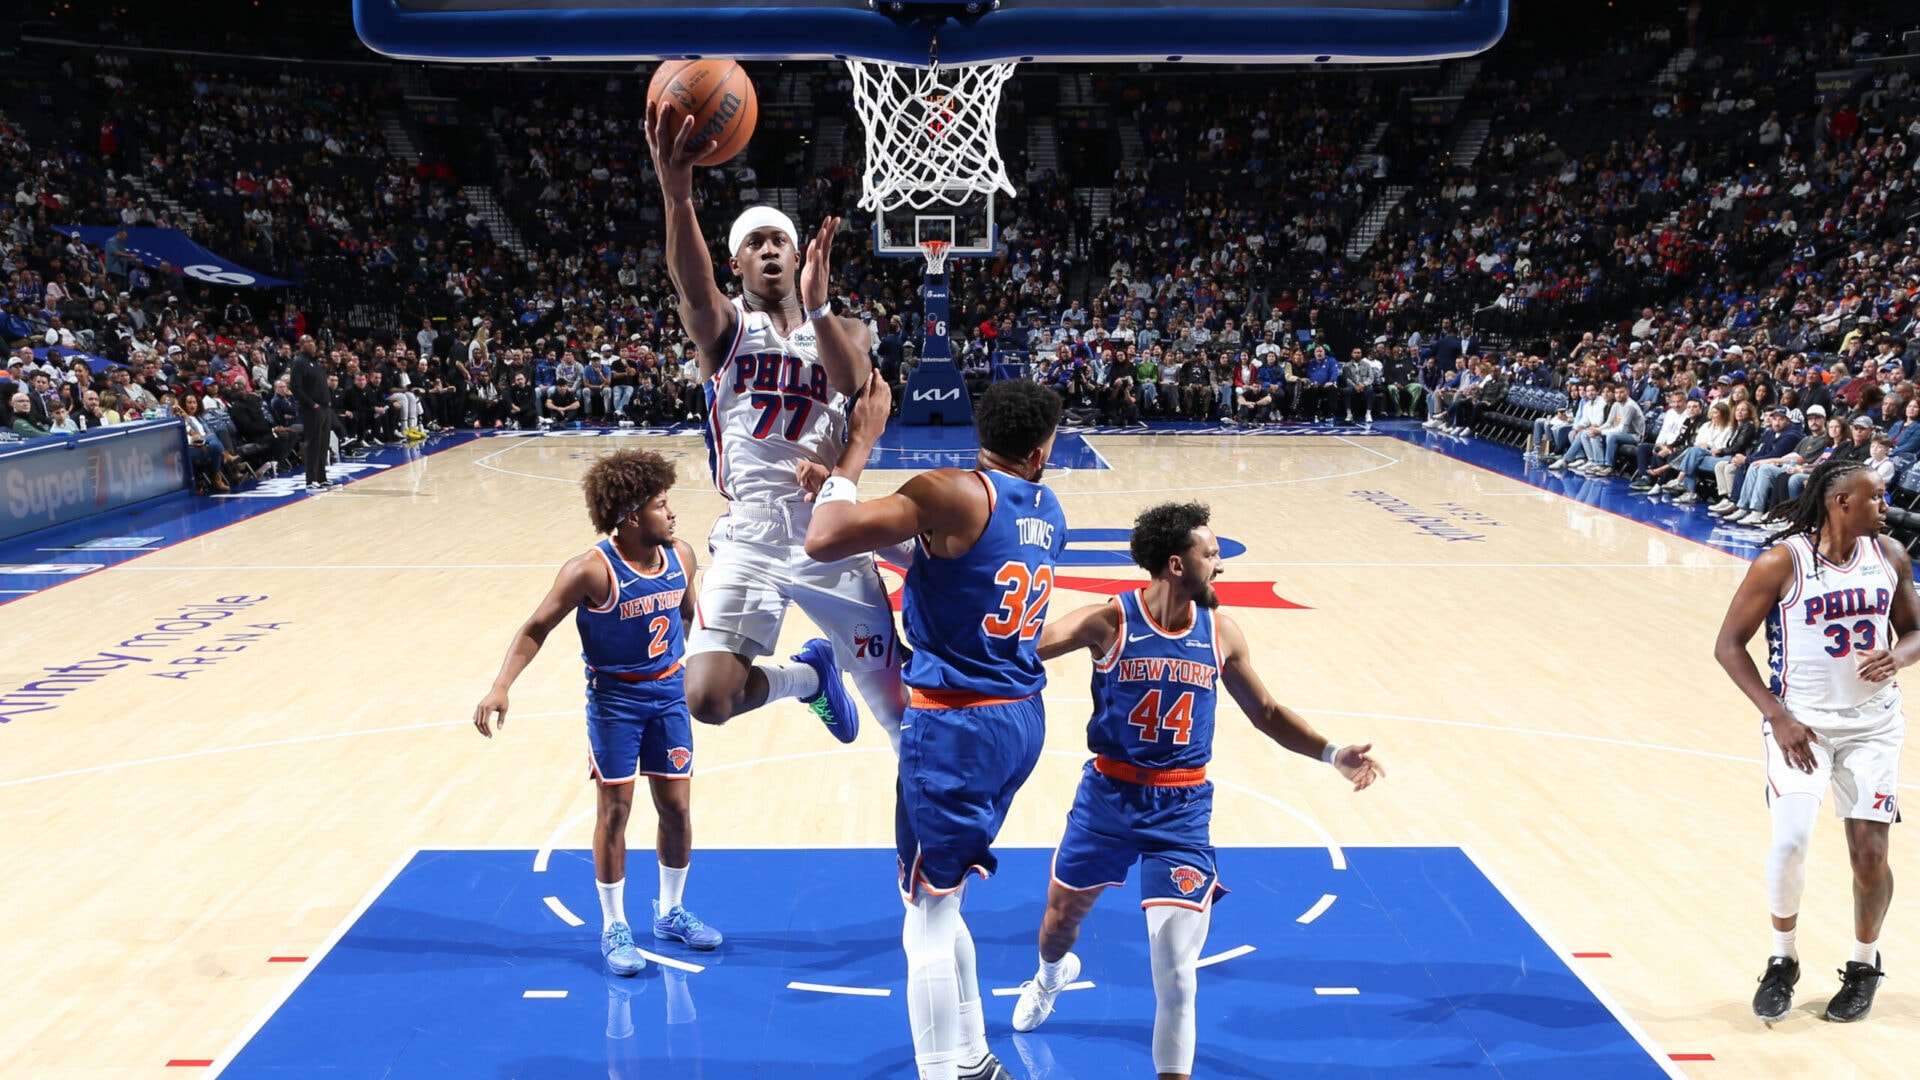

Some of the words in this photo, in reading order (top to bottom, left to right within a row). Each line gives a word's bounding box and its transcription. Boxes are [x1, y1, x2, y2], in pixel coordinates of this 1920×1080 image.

[795, 333, 816, 341] Bloo
[927, 320, 947, 337] 76
[733, 352, 828, 404] PHILA
[912, 387, 960, 401] KIA
[751, 393, 813, 440] 77
[6, 468, 87, 520] Super
[105, 448, 154, 500] Lyte
[821, 481, 834, 498] 2
[1016, 517, 1054, 550] TOWNS
[619, 595, 657, 620] NEW
[981, 561, 1054, 640] 32
[1804, 588, 1890, 625] PHILA
[114, 595, 268, 648] mobile
[648, 615, 670, 659] 2
[1824, 619, 1876, 658] 33
[147, 621, 293, 680] ARENA
[854, 634, 885, 659] 76
[1118, 657, 1166, 682] NEW
[1165, 658, 1216, 690] YORK
[1127, 689, 1195, 745] 44
[1872, 791, 1896, 813] 76
